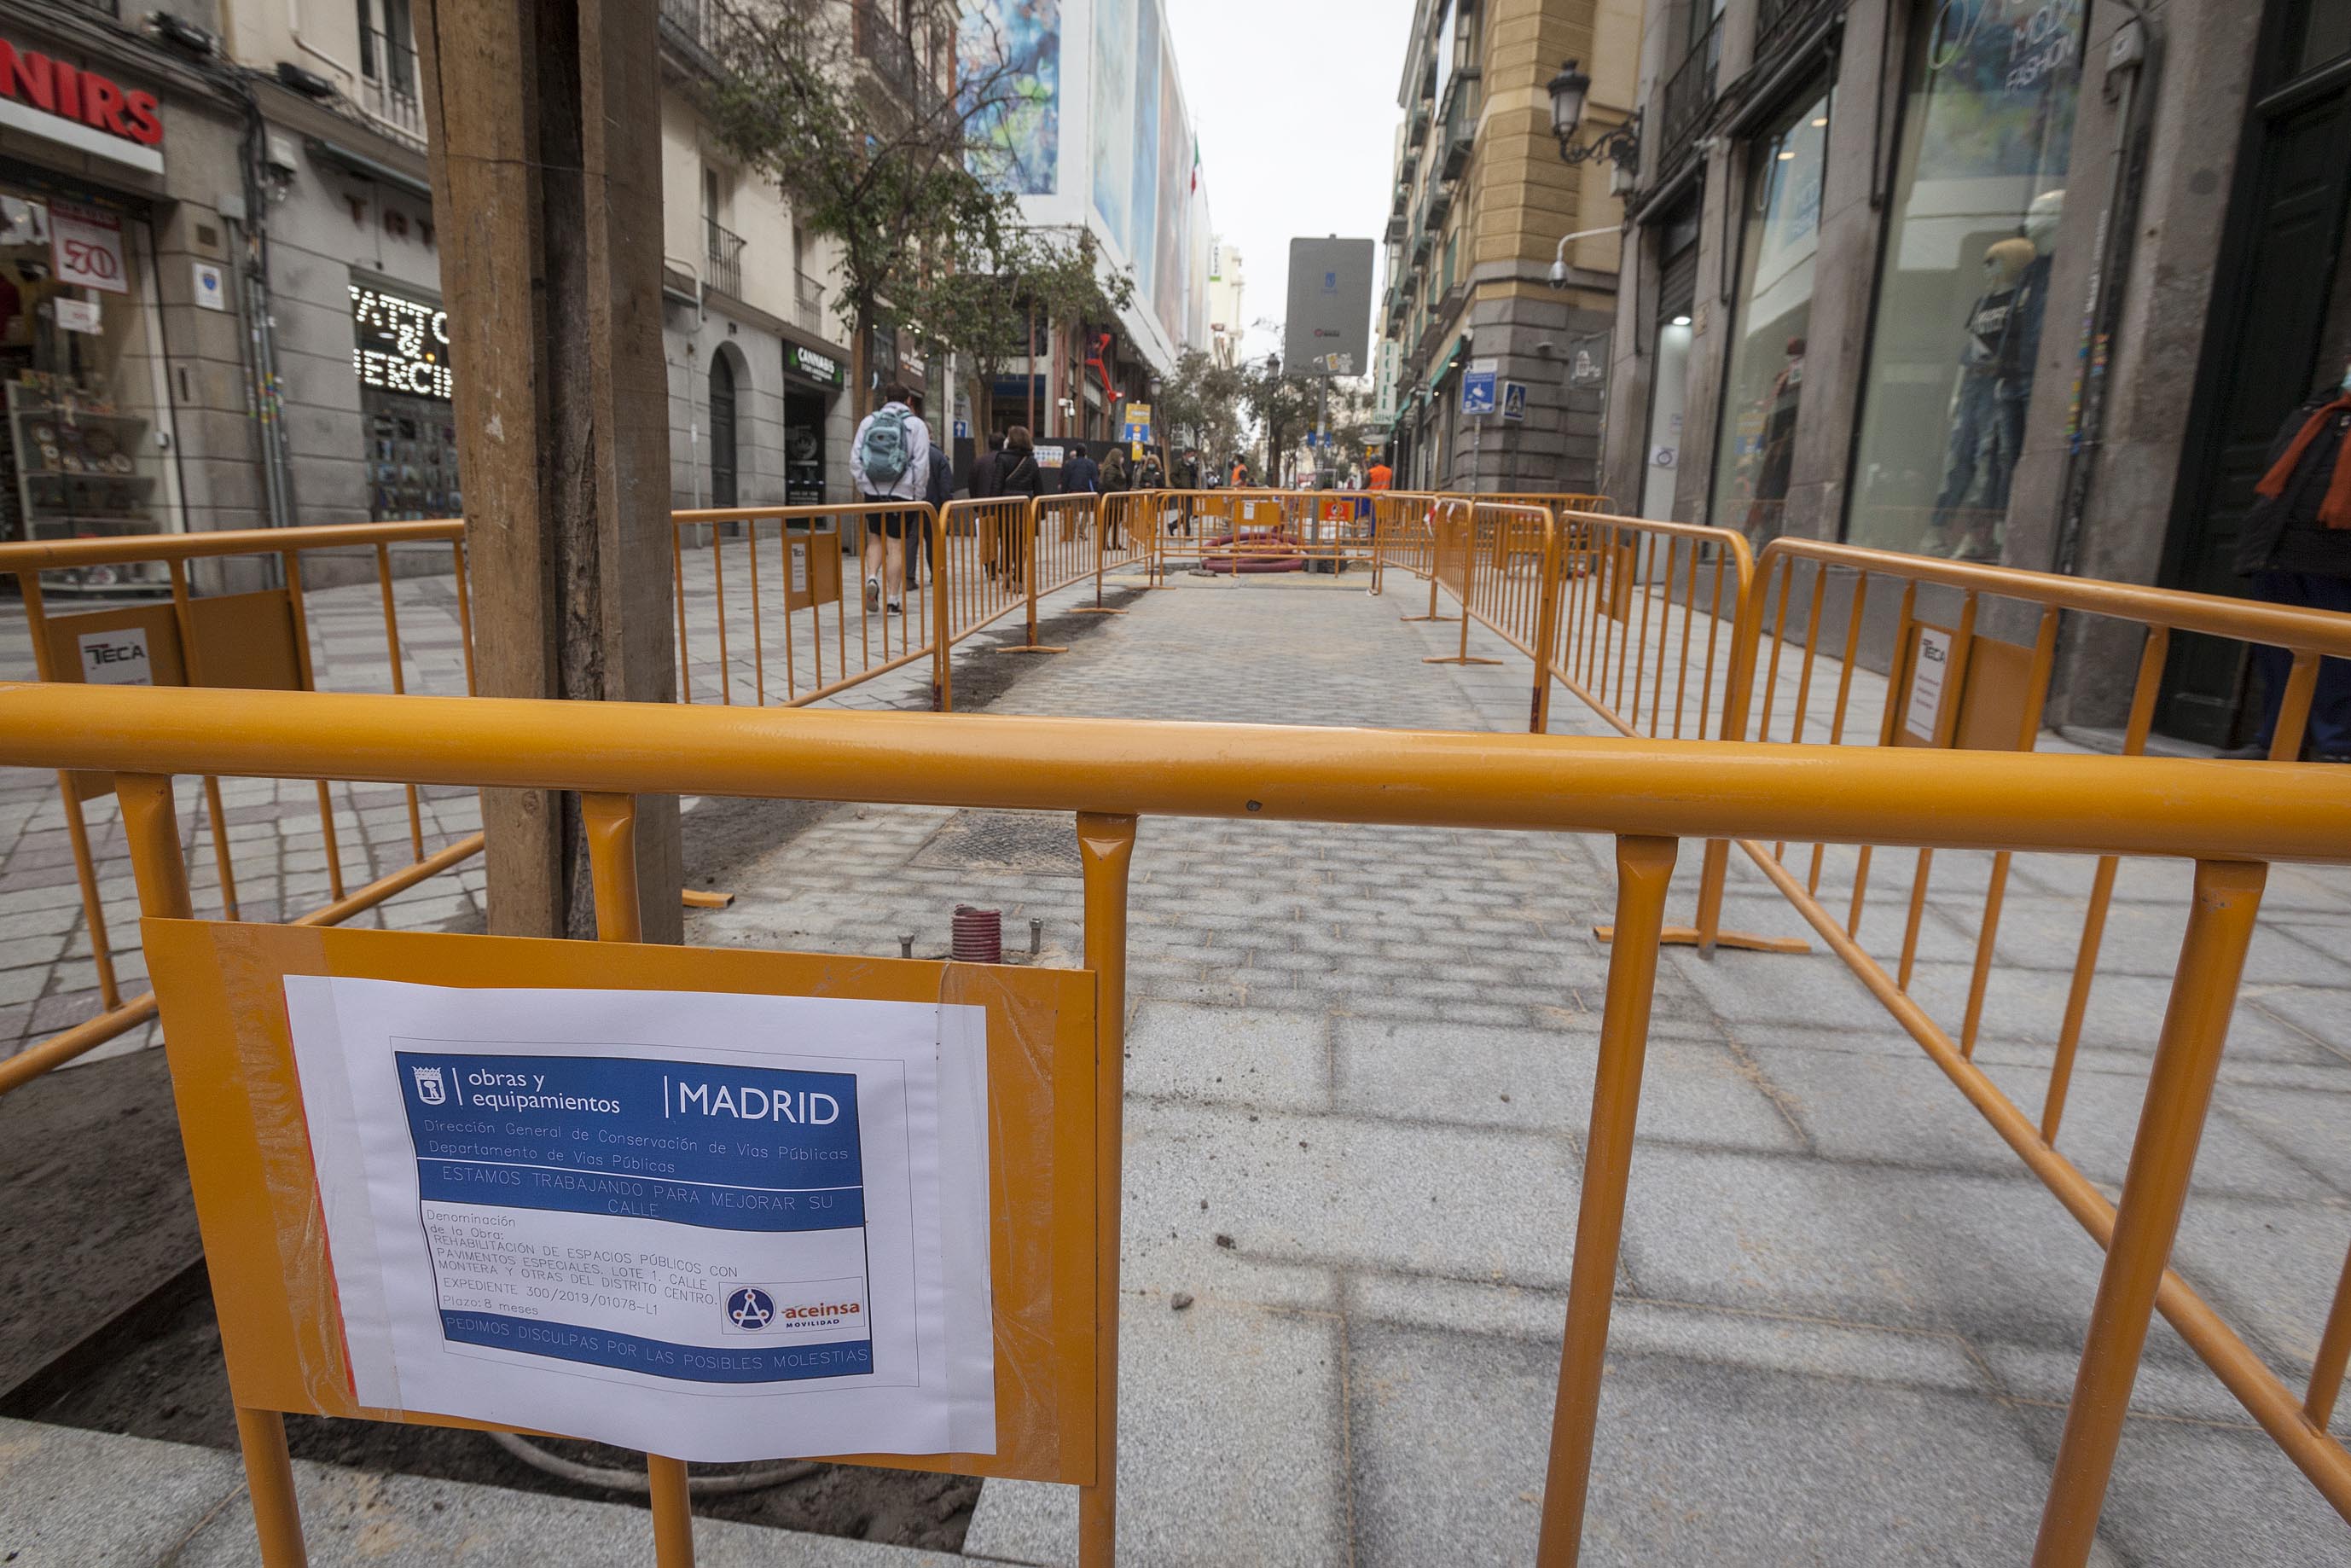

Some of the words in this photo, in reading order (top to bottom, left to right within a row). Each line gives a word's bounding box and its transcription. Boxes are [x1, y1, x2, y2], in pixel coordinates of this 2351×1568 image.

[798, 346, 835, 375] CANNABIS
[84, 643, 146, 665] TECA
[468, 1068, 527, 1087] obras
[533, 1074, 545, 1092] y
[473, 1091, 621, 1113] equipamientos
[679, 1082, 839, 1125] MADRID
[424, 1120, 495, 1134] Dirección
[505, 1123, 561, 1138] General
[572, 1128, 589, 1141] de
[598, 1130, 697, 1151] Conservación
[708, 1141, 726, 1153] de
[779, 1146, 848, 1160] Públicas
[429, 1140, 537, 1159] Departamento
[547, 1149, 564, 1161] de
[612, 1154, 675, 1172] Públicas
[443, 1166, 521, 1186] ESTAMOS
[531, 1172, 643, 1197] TRABAJANDO
[653, 1185, 700, 1204] PARA
[711, 1192, 796, 1210] MEJORAR
[809, 1195, 833, 1210] SU
[427, 1210, 516, 1228] Denominación
[607, 1199, 659, 1217] CALLE
[430, 1224, 444, 1234] de
[451, 1227, 462, 1236] la
[470, 1228, 504, 1240] Obra:
[434, 1235, 535, 1254] REHABILITACIÓN
[543, 1246, 560, 1257] DE
[567, 1248, 632, 1264] ESPACIOS
[640, 1253, 701, 1275] PÚBLICOS
[710, 1265, 738, 1277] CON
[437, 1247, 516, 1265] PAVIMENTOS
[523, 1257, 603, 1275] ESPECIALES.
[612, 1267, 643, 1279] LOTE
[652, 1270, 661, 1282] 1.
[670, 1274, 708, 1291] CALLE
[438, 1260, 498, 1275] MONTERA
[508, 1267, 514, 1276] Y
[521, 1269, 563, 1282] OTRAS
[570, 1274, 595, 1286] DEL
[601, 1277, 657, 1295] DISTRITO
[665, 1286, 717, 1305] CENTRO.
[444, 1278, 519, 1295] EXPEDIENTE
[526, 1286, 657, 1315] 300/2019/01078-L1
[499, 1304, 539, 1315] meses
[782, 1303, 860, 1319] aceinsa
[786, 1319, 840, 1328] MOVILIDAD
[445, 1317, 510, 1336] PEDIMOS
[519, 1326, 598, 1350] DISCULPAS
[607, 1340, 636, 1357] POR
[646, 1347, 674, 1365] LAS
[683, 1354, 763, 1369] POSIBLES
[774, 1349, 868, 1368] MOLESTIAS
